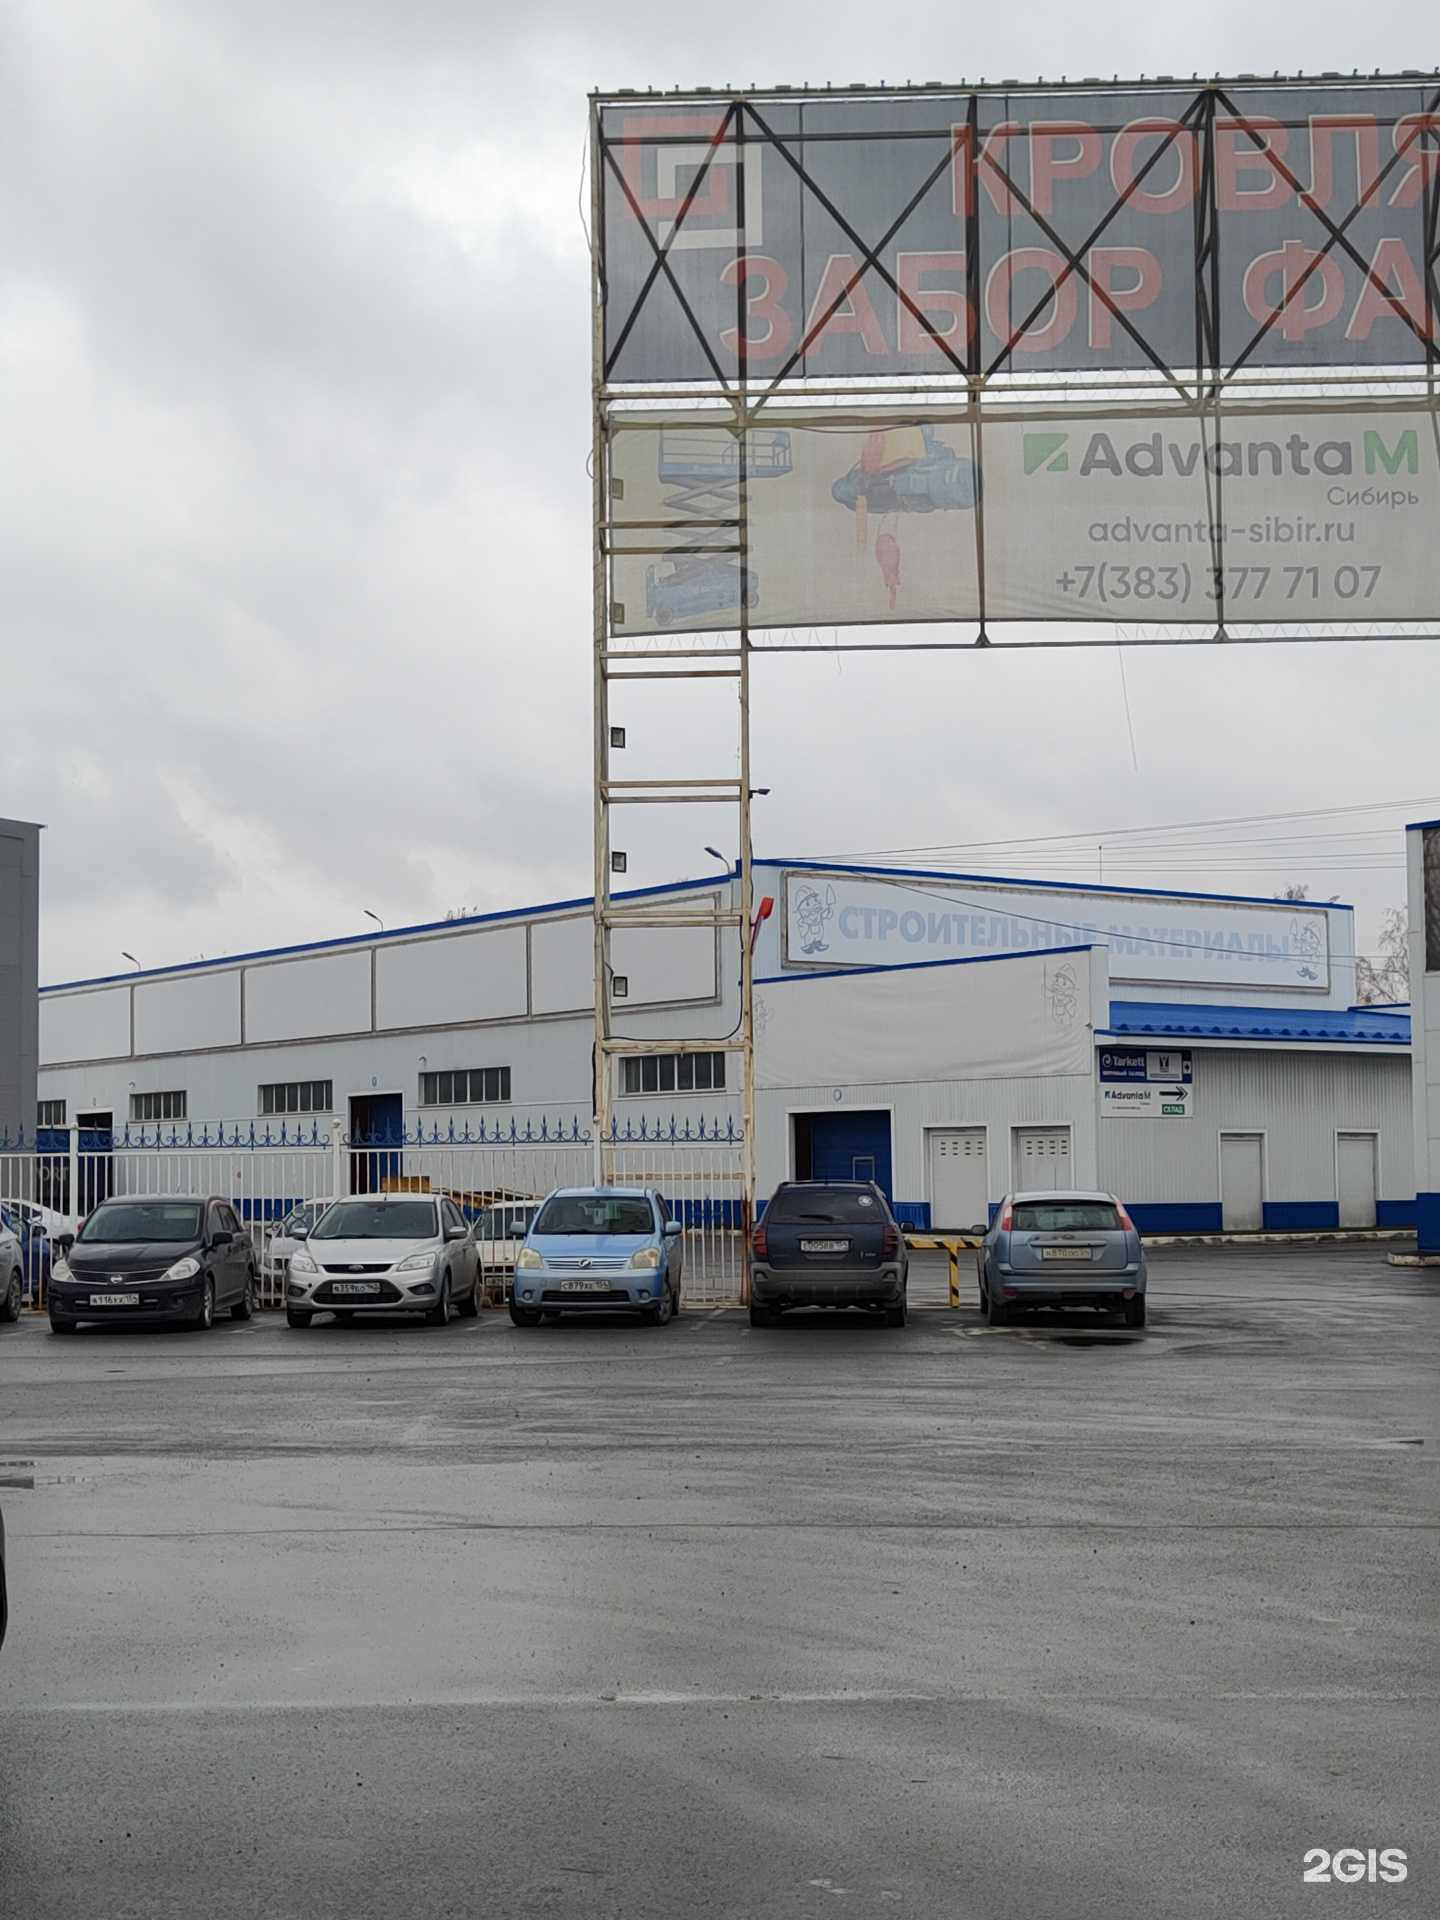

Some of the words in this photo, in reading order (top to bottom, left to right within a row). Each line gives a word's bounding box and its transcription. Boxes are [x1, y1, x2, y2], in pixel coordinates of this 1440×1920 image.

[950, 112, 1440, 217] КРОВЛЯ
[719, 246, 1164, 361] ЗАБОР
[1326, 486, 1420, 510] Сибирь
[1088, 516, 1355, 544] advanta-sibir.ru
[1056, 562, 1192, 603] +7(383)
[1283, 566, 1319, 598] 71
[1335, 566, 1382, 598] 07
[838, 905, 1098, 948] СТРОИТЕЛЬНЫЕ
[1108, 923, 1289, 963] МАТЕРИАЛЫ
